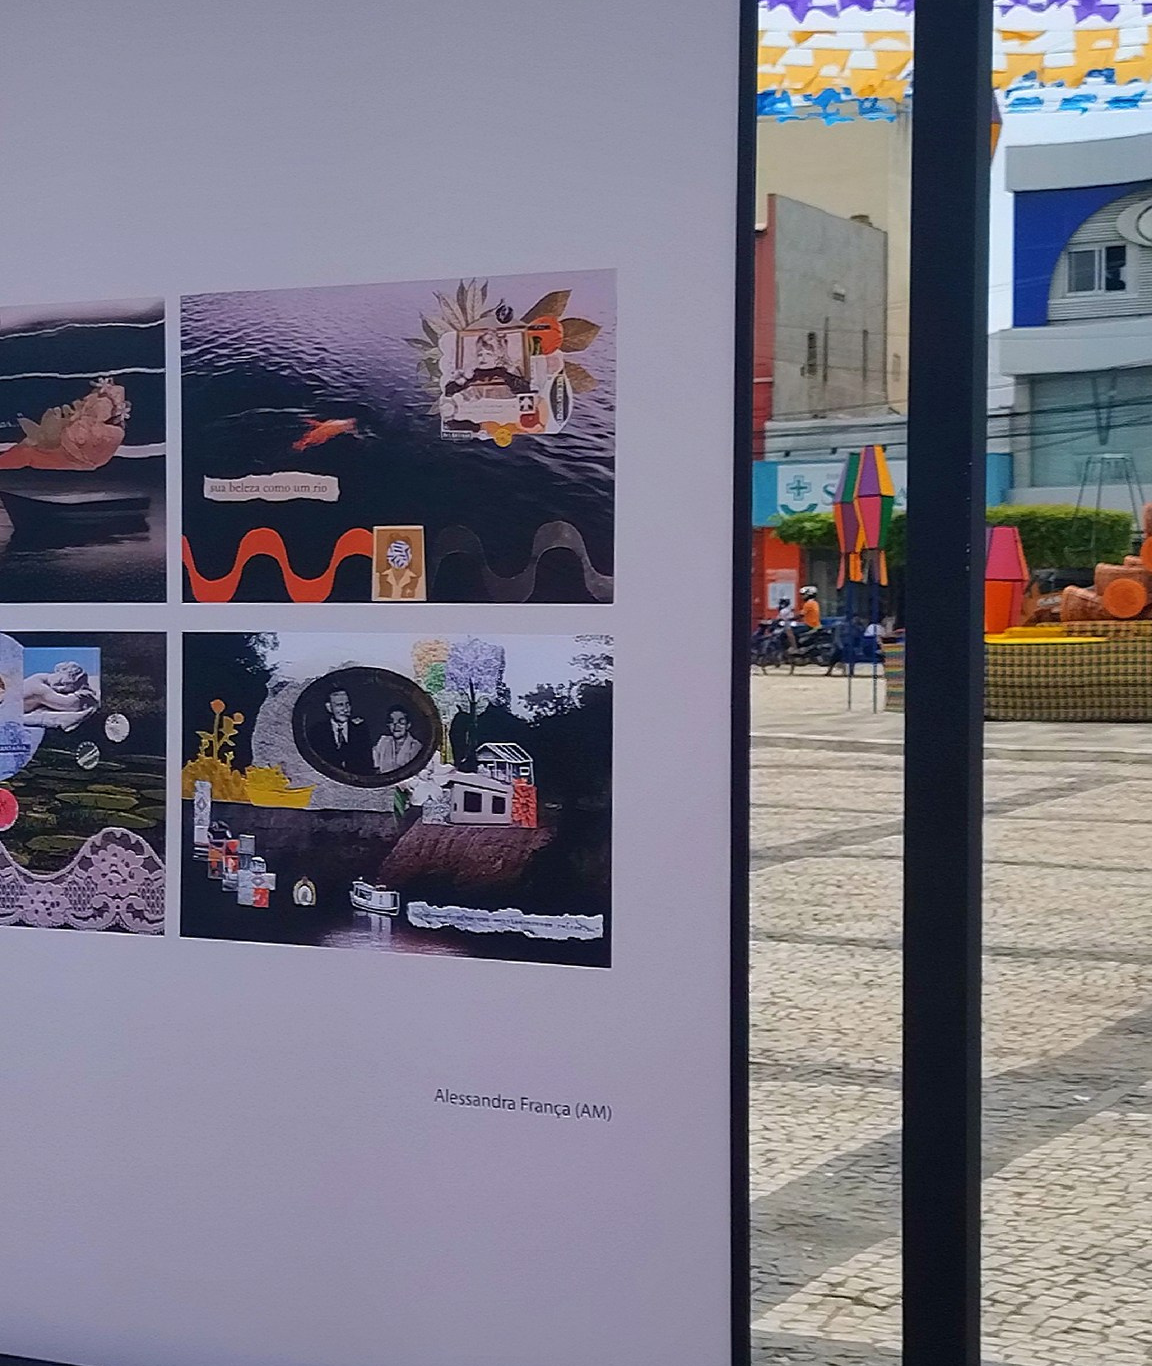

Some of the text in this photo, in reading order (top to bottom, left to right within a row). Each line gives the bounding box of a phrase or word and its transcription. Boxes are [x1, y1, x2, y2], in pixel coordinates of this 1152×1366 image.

[210, 482, 328, 493] sua beleza como um rio
[434, 1088, 613, 1122] Alessandra França (AM)
